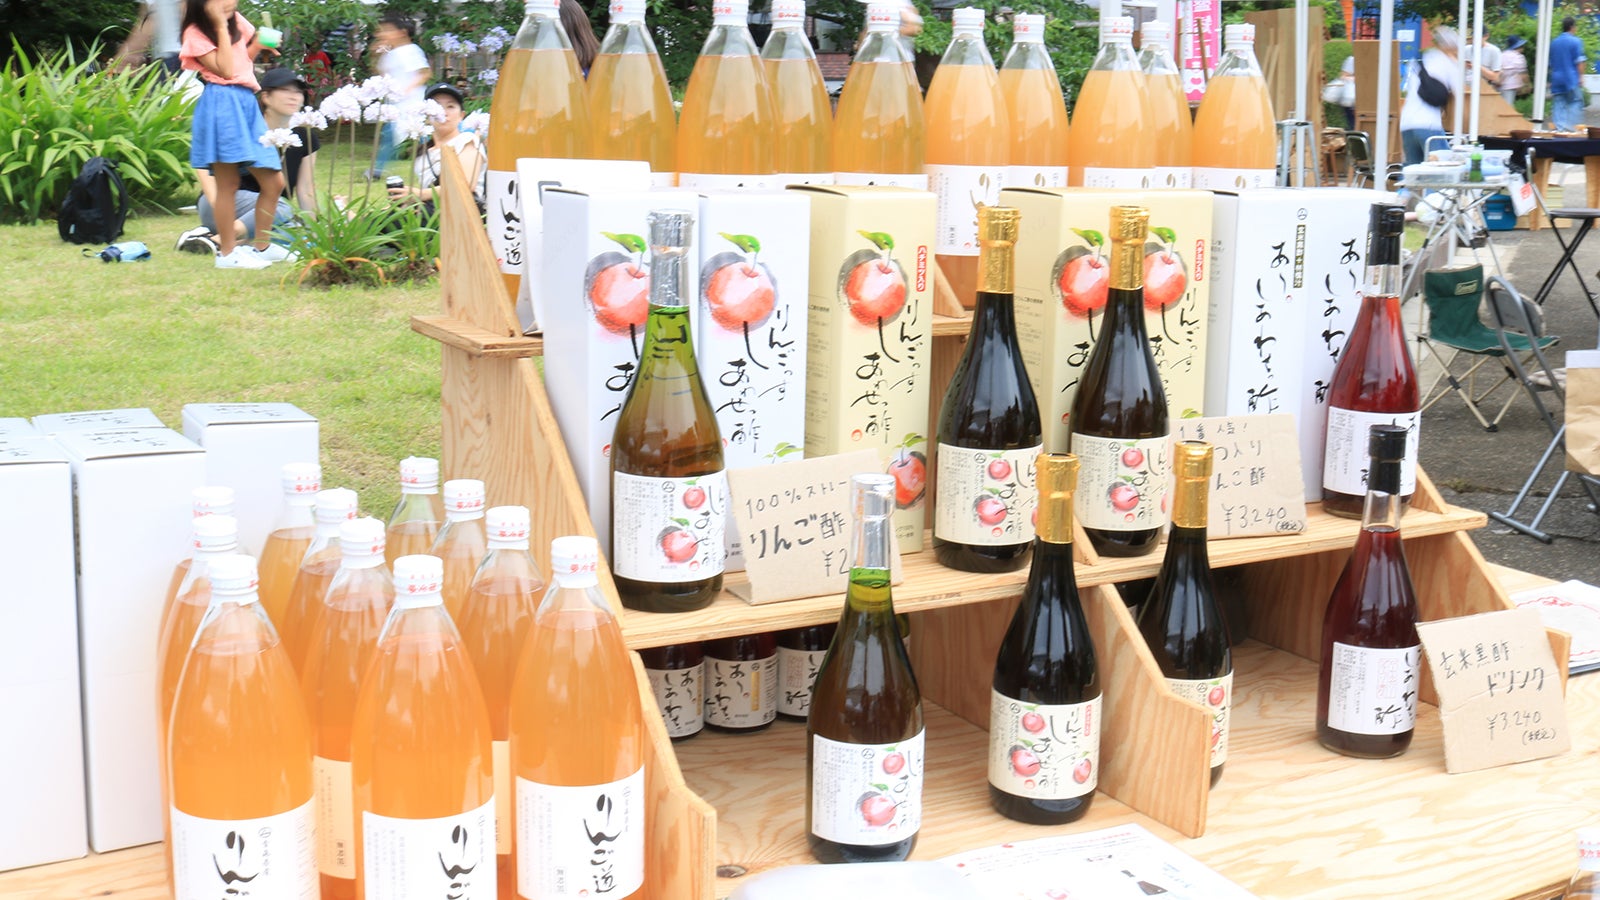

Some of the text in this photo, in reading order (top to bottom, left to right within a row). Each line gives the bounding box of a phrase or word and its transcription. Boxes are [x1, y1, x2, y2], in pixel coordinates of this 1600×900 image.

[917, 246, 927, 291] ハチミツ入り
[758, 304, 795, 401] りんごっす
[889, 299, 922, 393] りんごっす
[746, 481, 847, 519] 100%ストレー
[1215, 466, 1267, 490] んご酢
[750, 511, 846, 559] りんご酢
[1440, 640, 1510, 679] 玄米黒酢
[1487, 667, 1544, 697] ドリンク
[438, 824, 477, 900] りんご
[583, 793, 622, 894] りんご道
